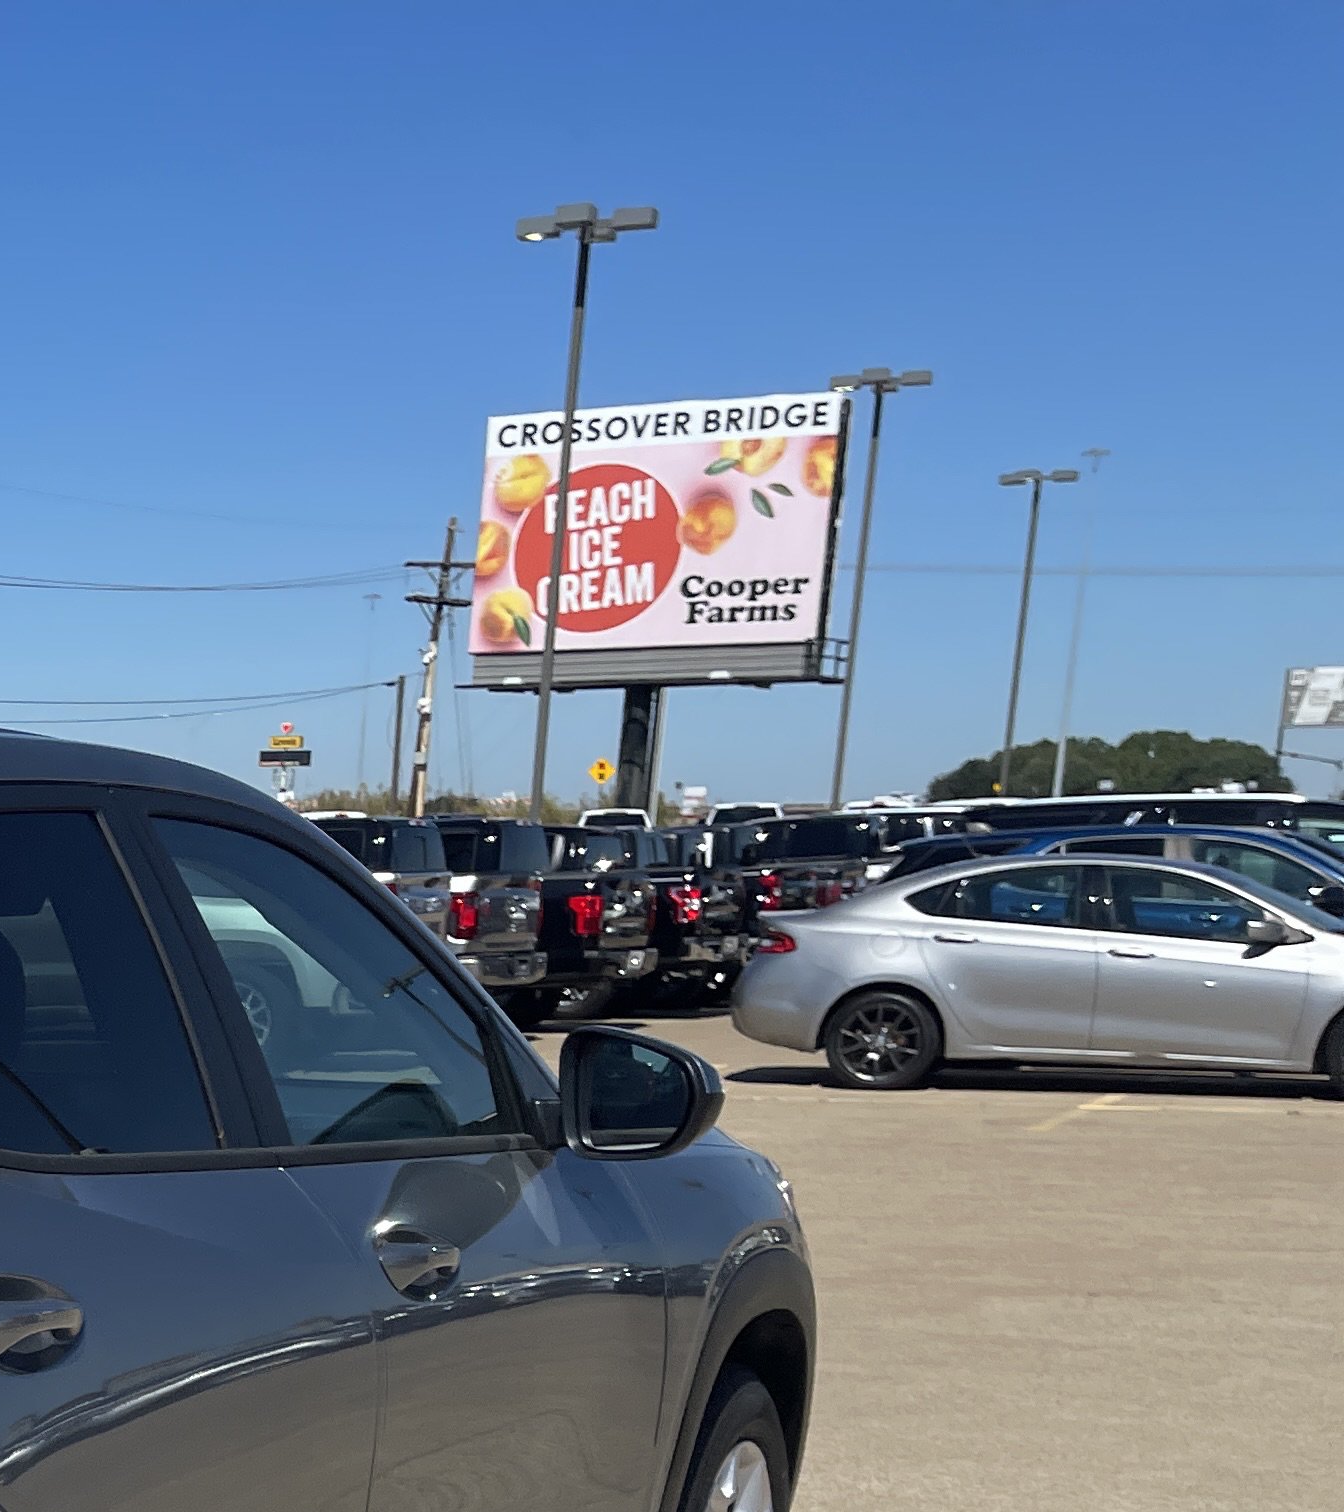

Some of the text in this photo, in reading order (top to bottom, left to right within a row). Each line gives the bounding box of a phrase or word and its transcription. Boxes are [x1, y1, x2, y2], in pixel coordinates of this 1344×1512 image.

[498, 401, 830, 448] CROSSOVER BRIDGE
[569, 526, 624, 572] ICE
[680, 575, 810, 605] Cooper
[685, 600, 797, 625] Farms
